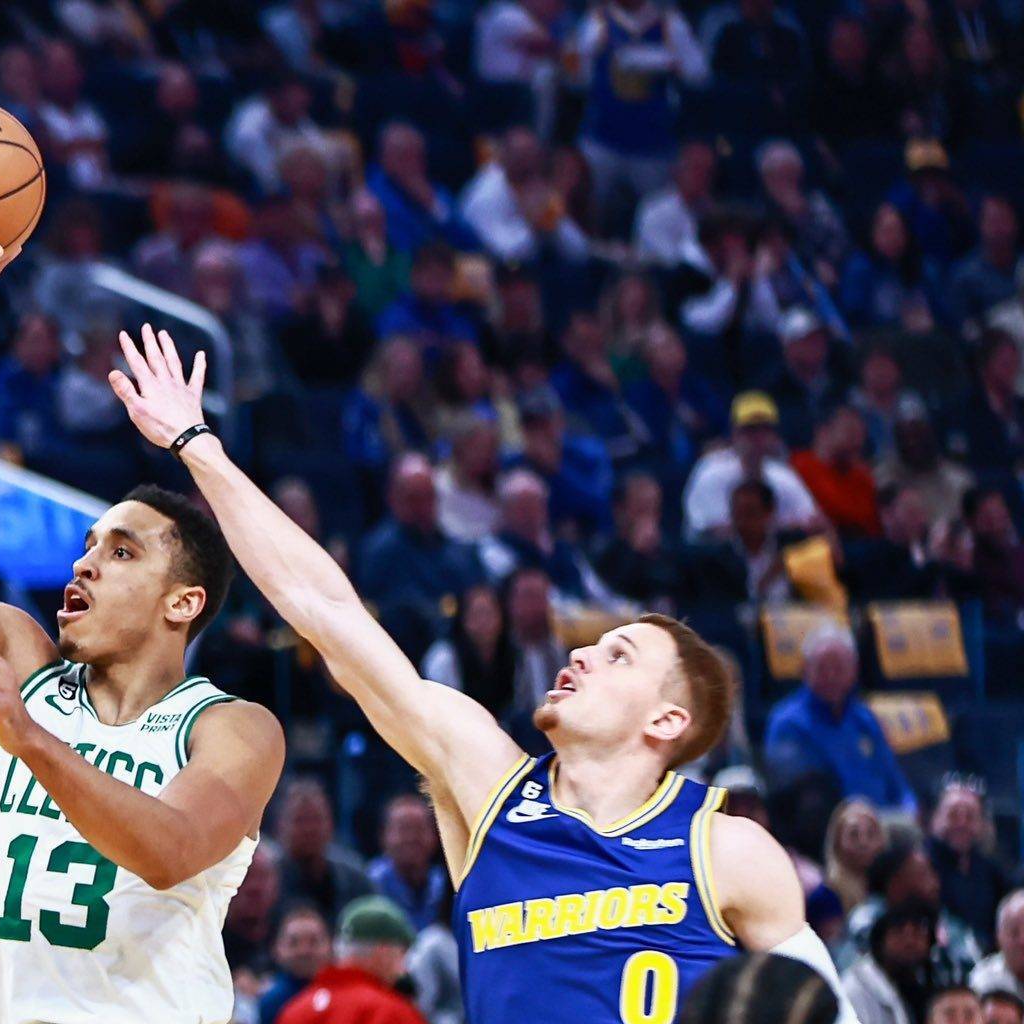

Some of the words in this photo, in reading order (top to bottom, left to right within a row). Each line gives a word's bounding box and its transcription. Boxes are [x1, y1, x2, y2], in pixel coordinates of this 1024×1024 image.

[147, 712, 183, 724] VISTA
[140, 723, 176, 733] PRINT
[521, 780, 543, 800] 6
[467, 882, 691, 953] WARRIORS
